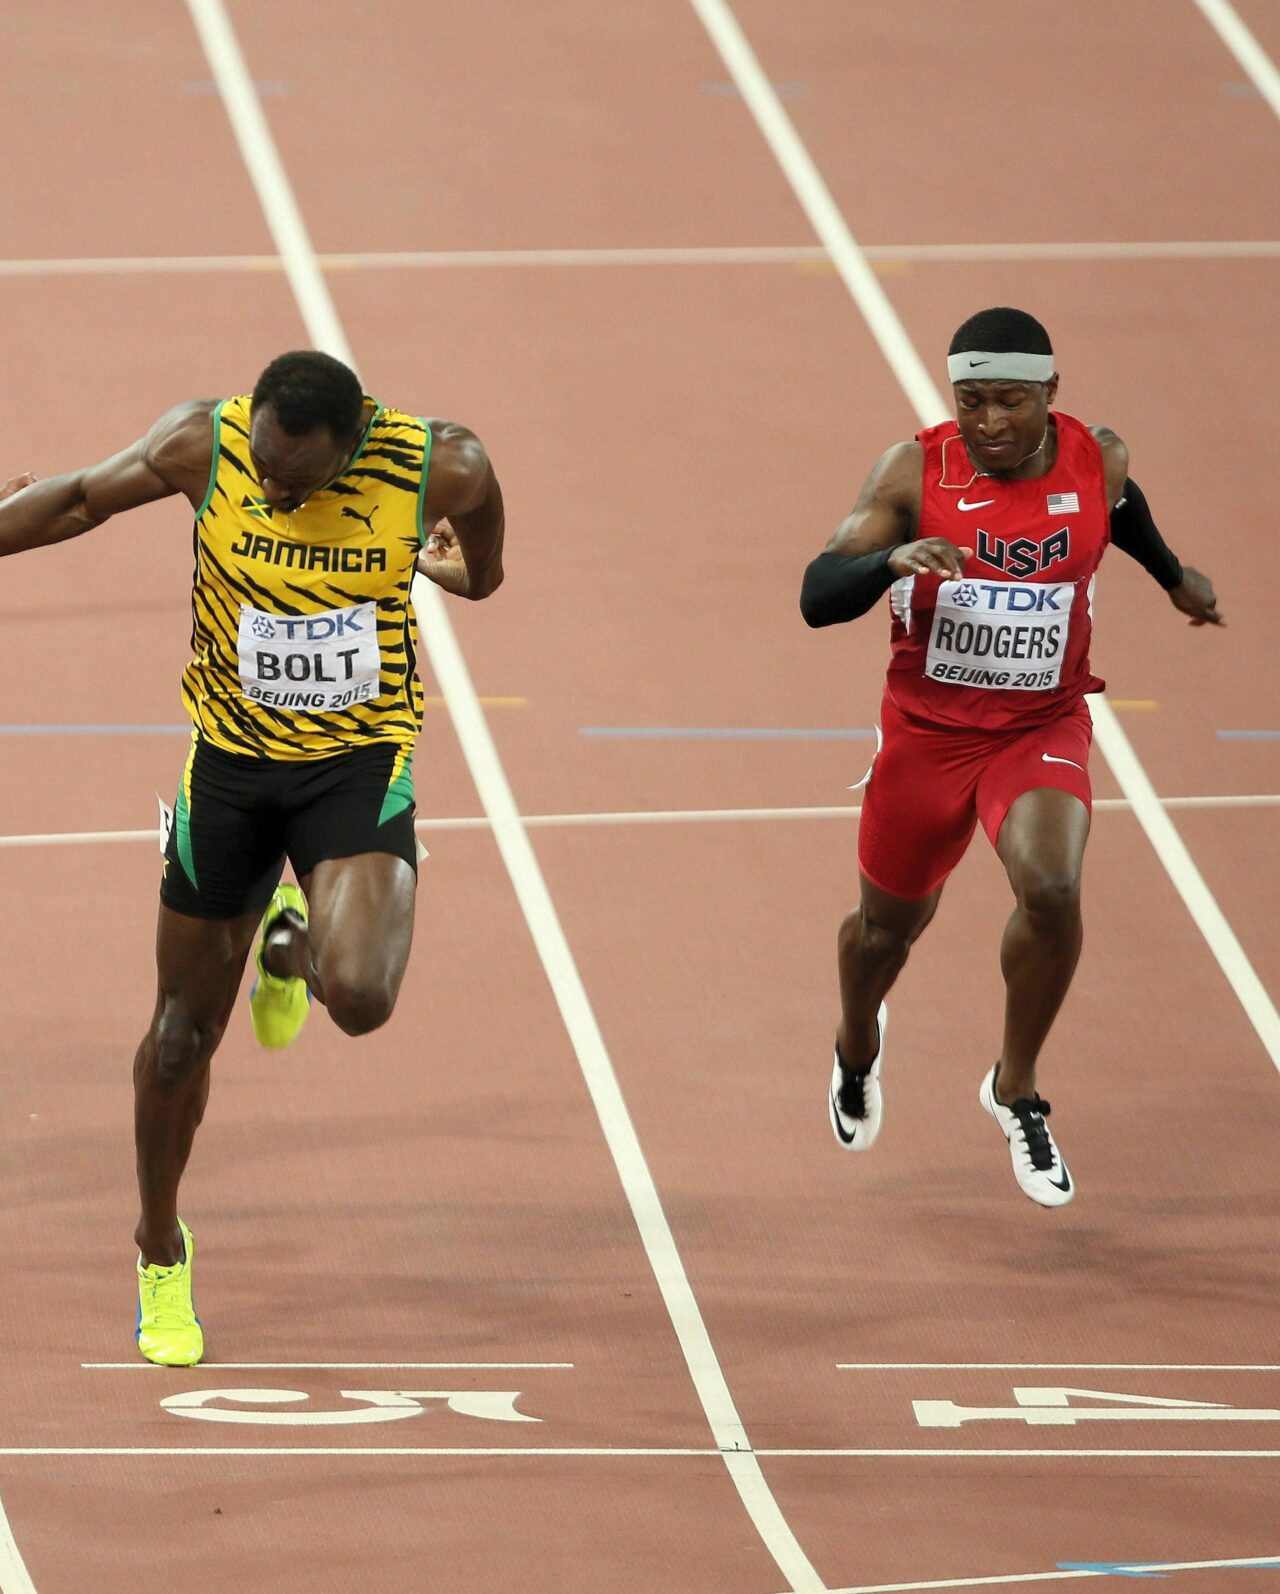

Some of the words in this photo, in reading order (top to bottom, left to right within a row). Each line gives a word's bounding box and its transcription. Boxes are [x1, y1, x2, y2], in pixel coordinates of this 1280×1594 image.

[231, 531, 386, 572] JAMAICA
[976, 526, 1069, 579] USA
[980, 585, 1063, 612] TDK
[276, 608, 364, 640] TDK
[935, 617, 1060, 659] RODGERS
[256, 648, 360, 682] BOLT
[931, 663, 1010, 686] BEIJING
[1012, 670, 1055, 687] 2015
[248, 687, 324, 707] BEIJING
[329, 683, 372, 708] 2015
[159, 1388, 544, 1425] 5
[912, 1387, 1280, 1427] 4
